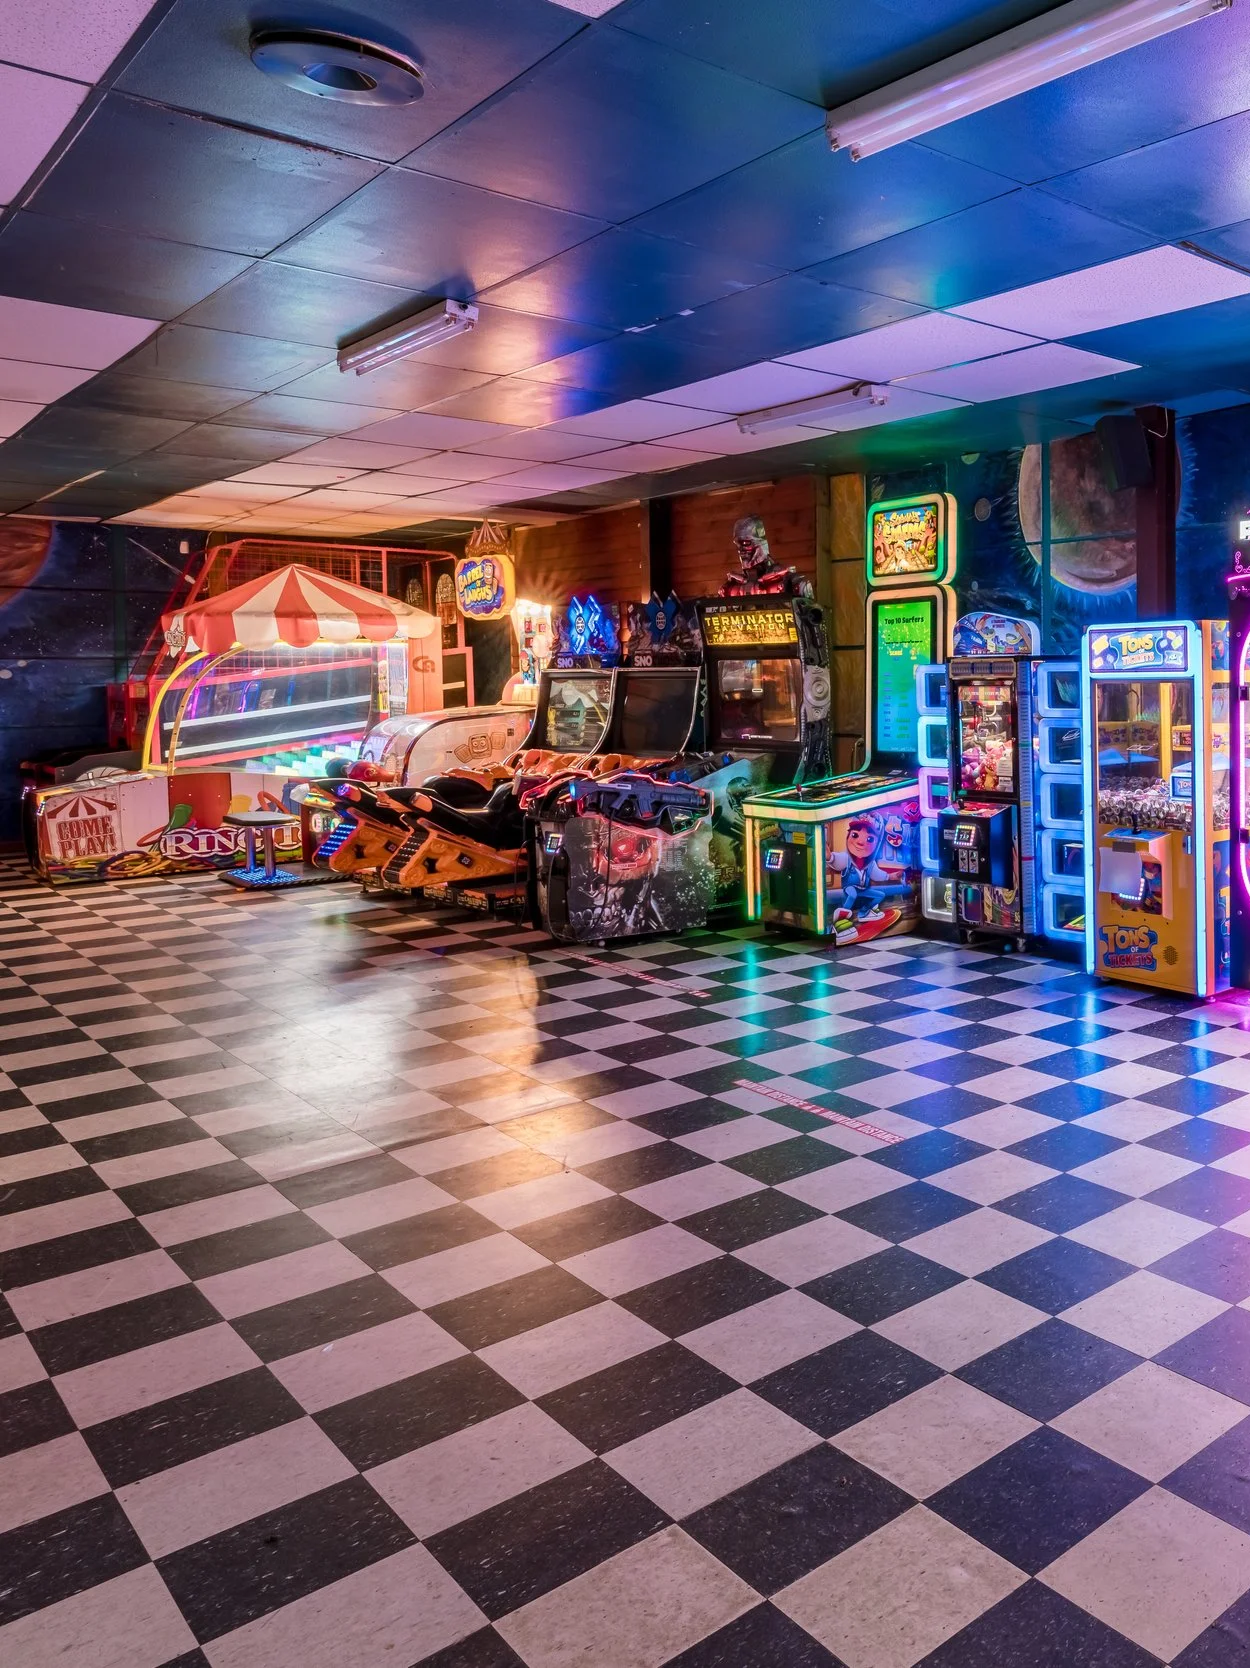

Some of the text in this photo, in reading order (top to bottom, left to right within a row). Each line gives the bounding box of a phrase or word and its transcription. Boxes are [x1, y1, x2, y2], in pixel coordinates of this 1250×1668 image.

[704, 613, 794, 627] TERMINATOR
[714, 623, 785, 633] SALVATION
[1118, 633, 1154, 656] TONS
[56, 815, 113, 838] COME
[57, 835, 117, 860] PLAY!
[163, 830, 264, 858] RING
[1102, 925, 1150, 953] TONS
[1109, 952, 1153, 968] TICKETS
